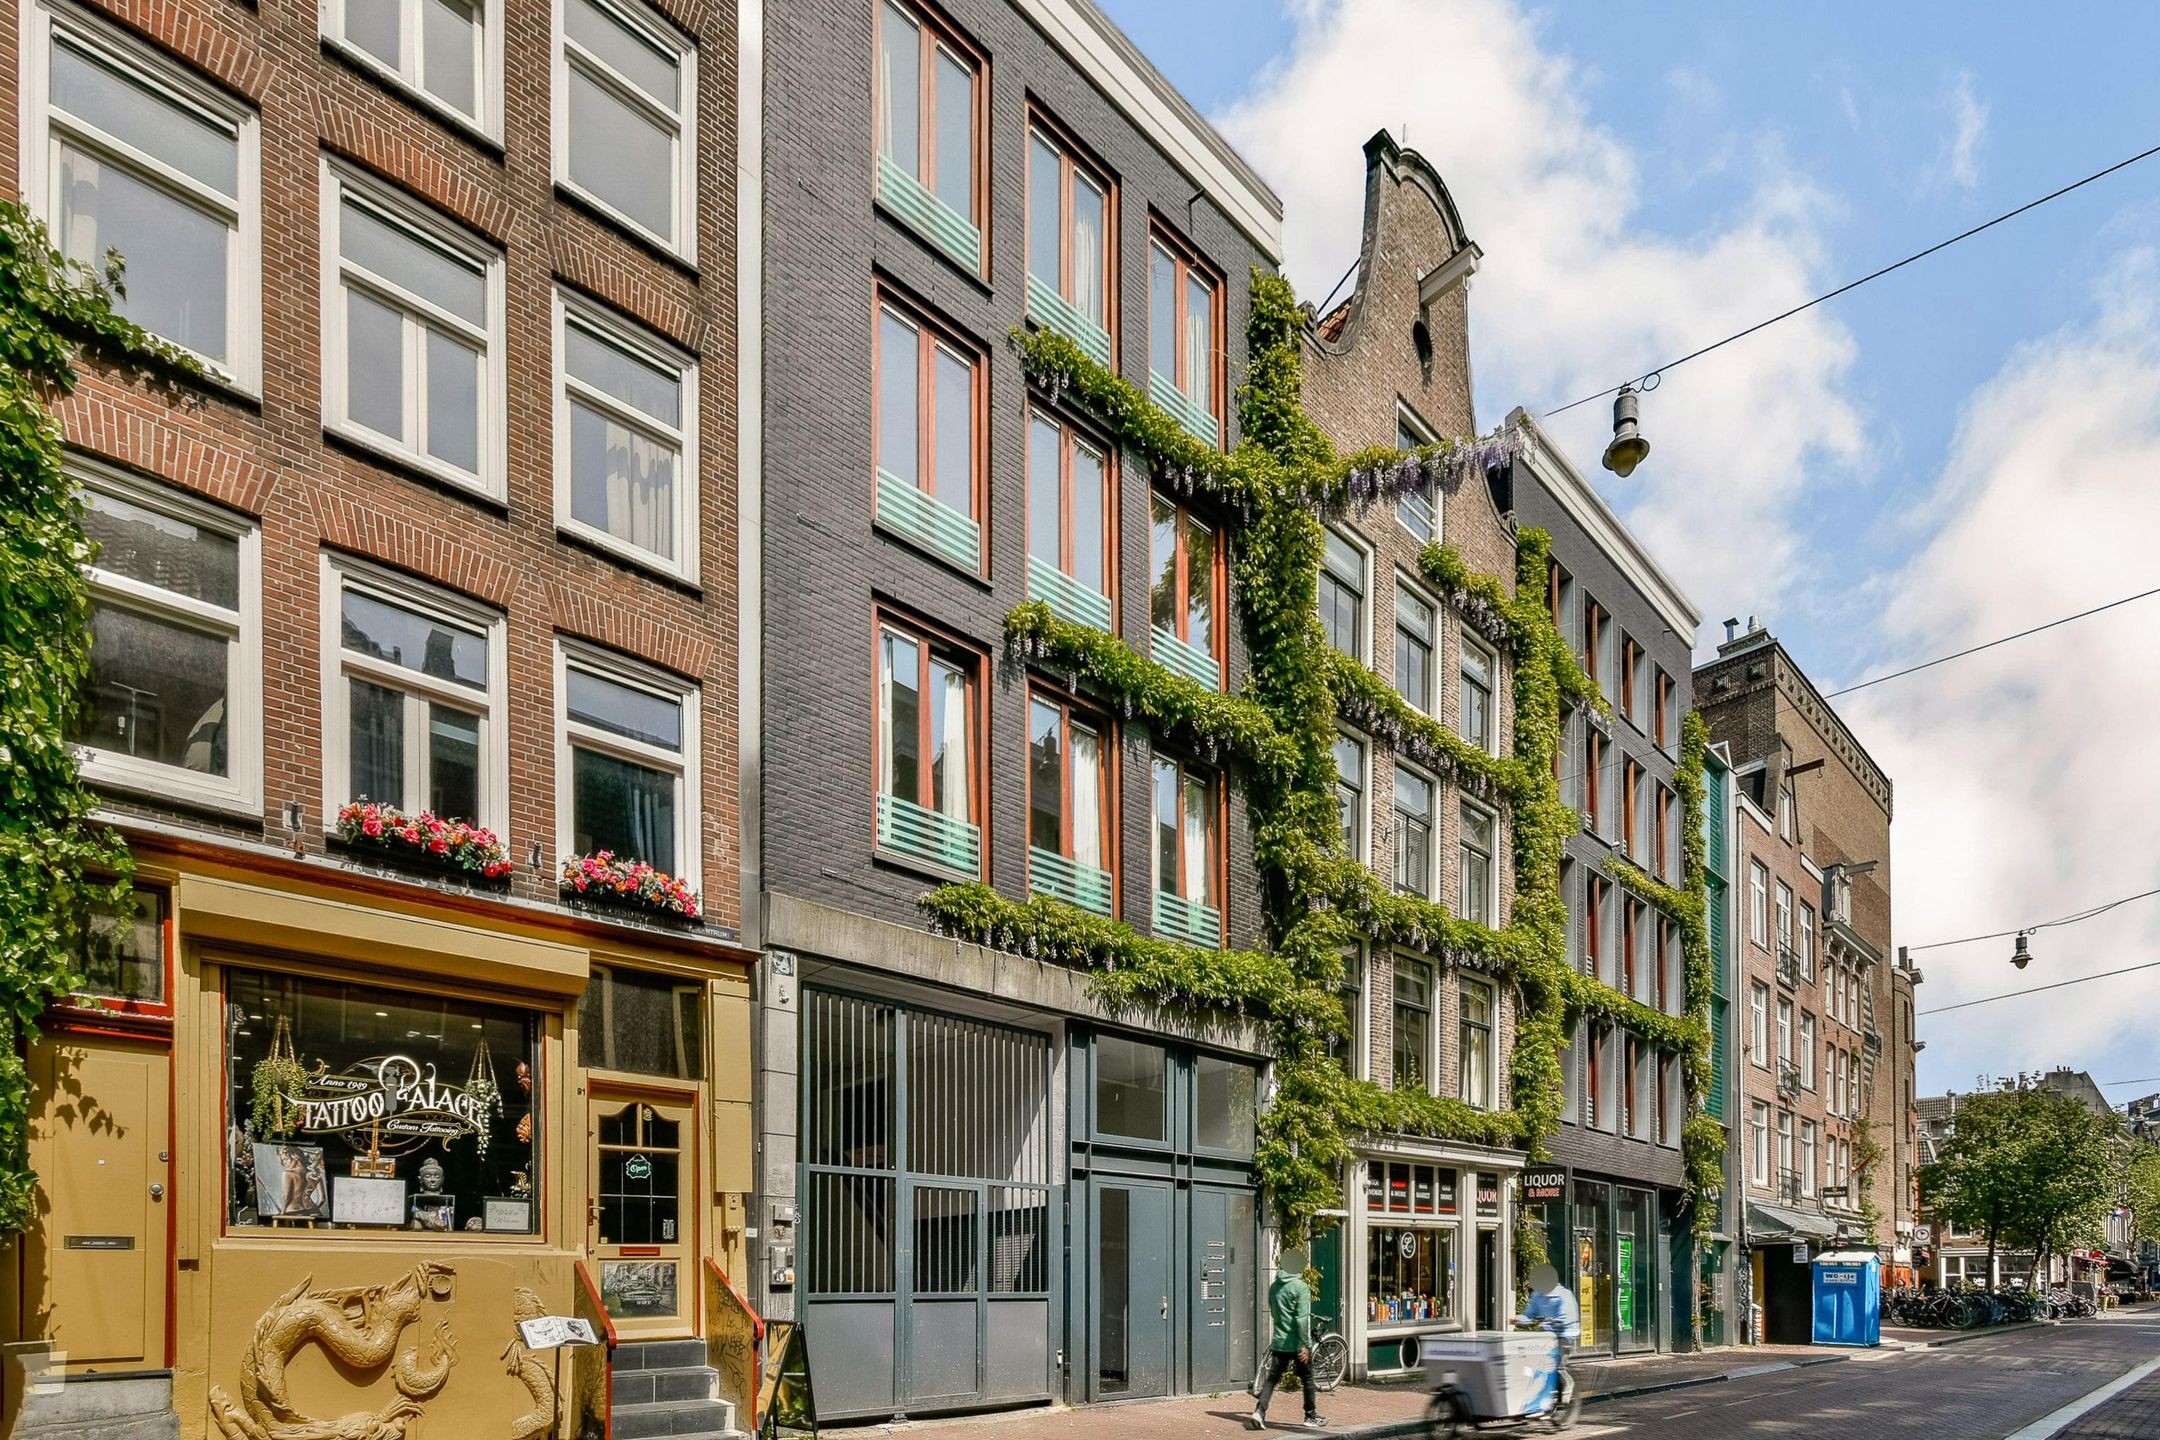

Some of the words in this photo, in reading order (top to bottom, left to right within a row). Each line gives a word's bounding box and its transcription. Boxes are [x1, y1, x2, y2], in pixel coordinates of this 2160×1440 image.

[308, 1074, 344, 1087] Anno
[295, 1092, 385, 1129] TATTOO
[386, 1118, 418, 1131] Custom
[419, 1122, 459, 1136] Tattooing
[1524, 1174, 1565, 1187] LIQUOR
[1536, 1187, 1560, 1197] MORE
